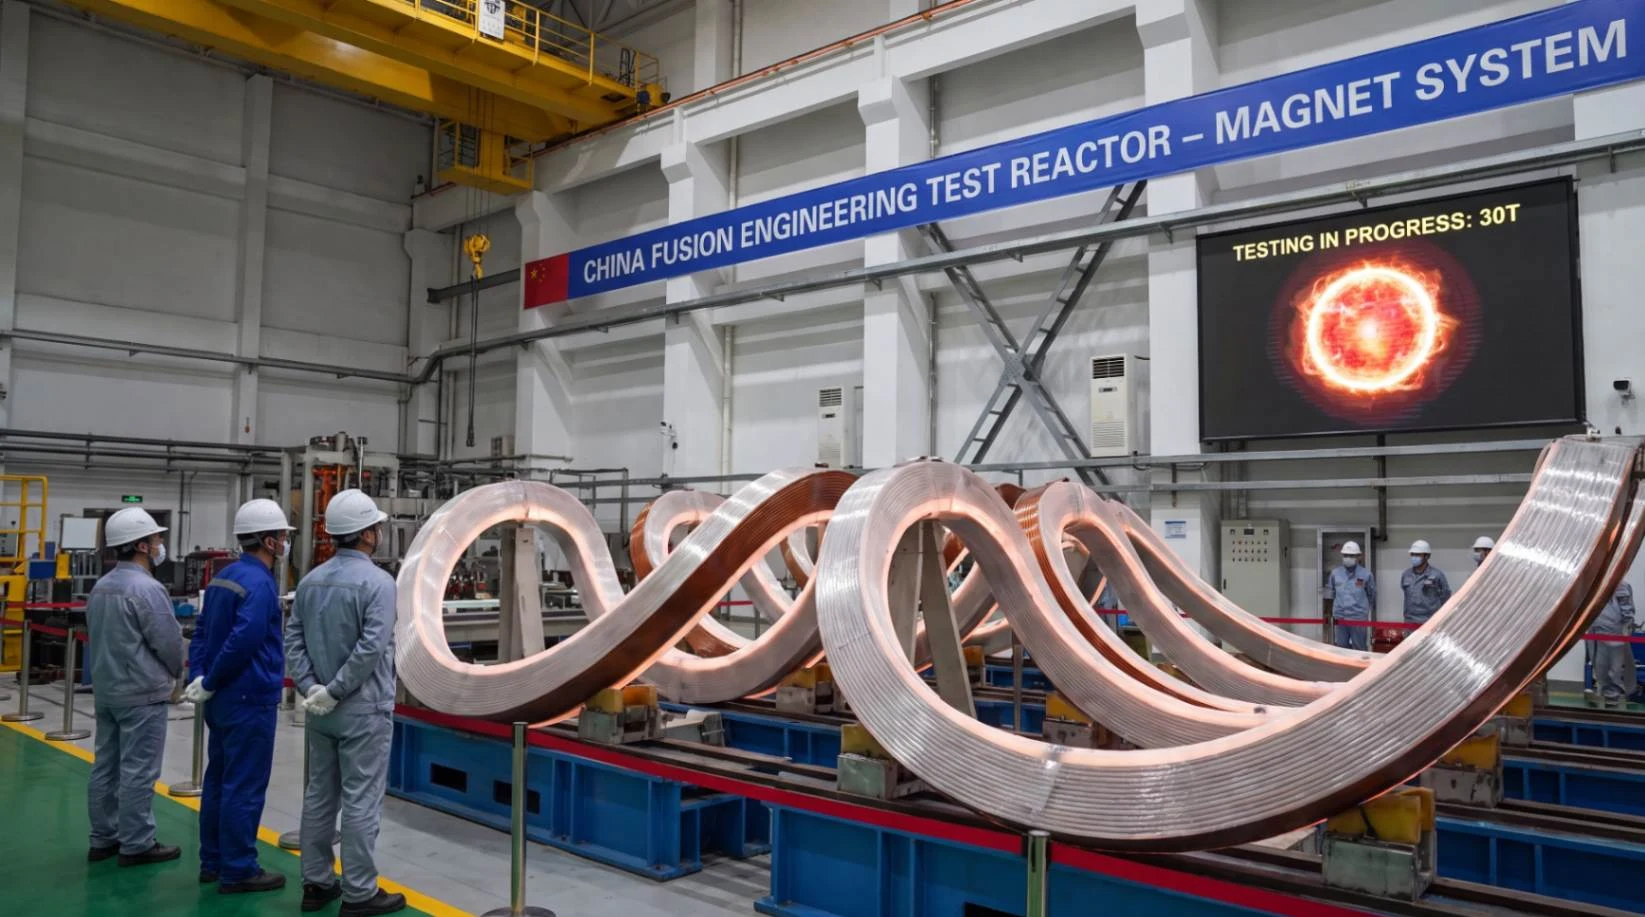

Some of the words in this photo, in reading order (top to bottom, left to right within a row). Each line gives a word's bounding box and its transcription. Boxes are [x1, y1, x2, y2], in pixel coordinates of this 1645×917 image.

[583, 248, 645, 283] CHINA
[652, 226, 733, 268] FUSION
[741, 182, 917, 249] ENGINEERING
[926, 162, 1002, 206] TEST
[1010, 124, 1171, 189] REACTOR
[1215, 71, 1401, 145] MAGNET
[1415, 18, 1626, 101] SYSTEM
[1233, 234, 1315, 262] TESTING
[1319, 230, 1339, 250] IN
[1345, 214, 1472, 246] PROGRESS:
[1479, 203, 1521, 227] 30T
